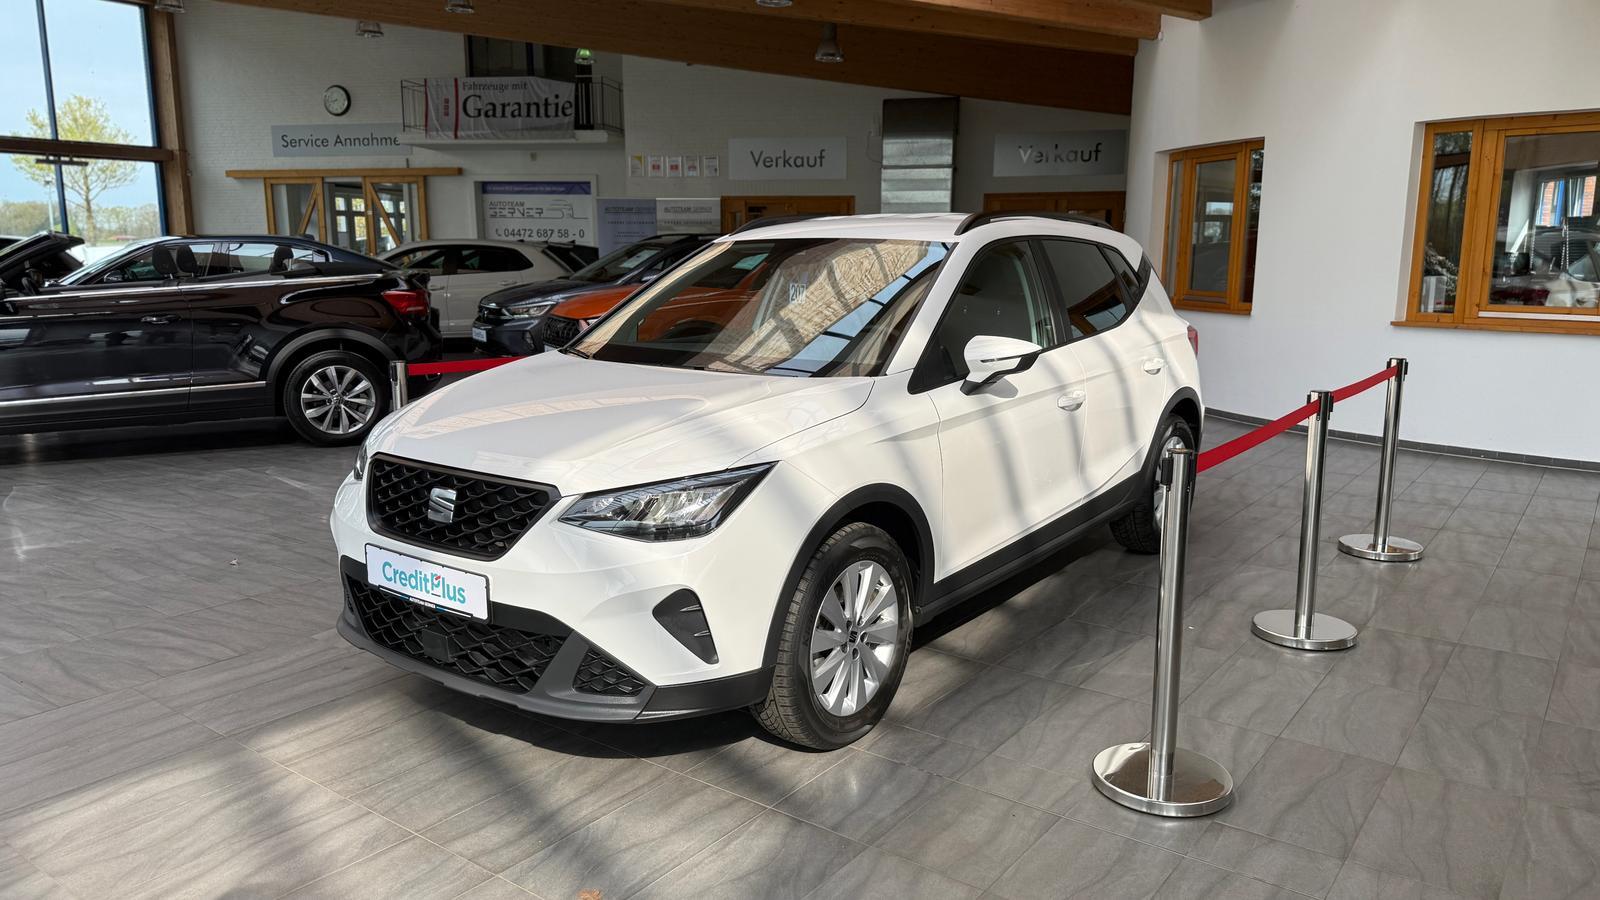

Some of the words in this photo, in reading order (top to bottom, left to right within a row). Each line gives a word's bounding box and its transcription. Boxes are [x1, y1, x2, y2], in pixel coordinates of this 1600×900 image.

[462, 80, 509, 94] Fahrzeuge
[511, 82, 528, 91] mit
[462, 95, 573, 121] Garantie
[281, 134, 329, 149] Service
[333, 133, 401, 148] Annahme
[750, 149, 825, 168] Verkauf
[1018, 143, 1102, 163] Verkauf
[503, 229, 535, 238] 04472
[536, 229, 554, 238] 687
[557, 229, 570, 238] 58
[578, 229, 585, 238] 0
[382, 561, 466, 604] CreditPlus
